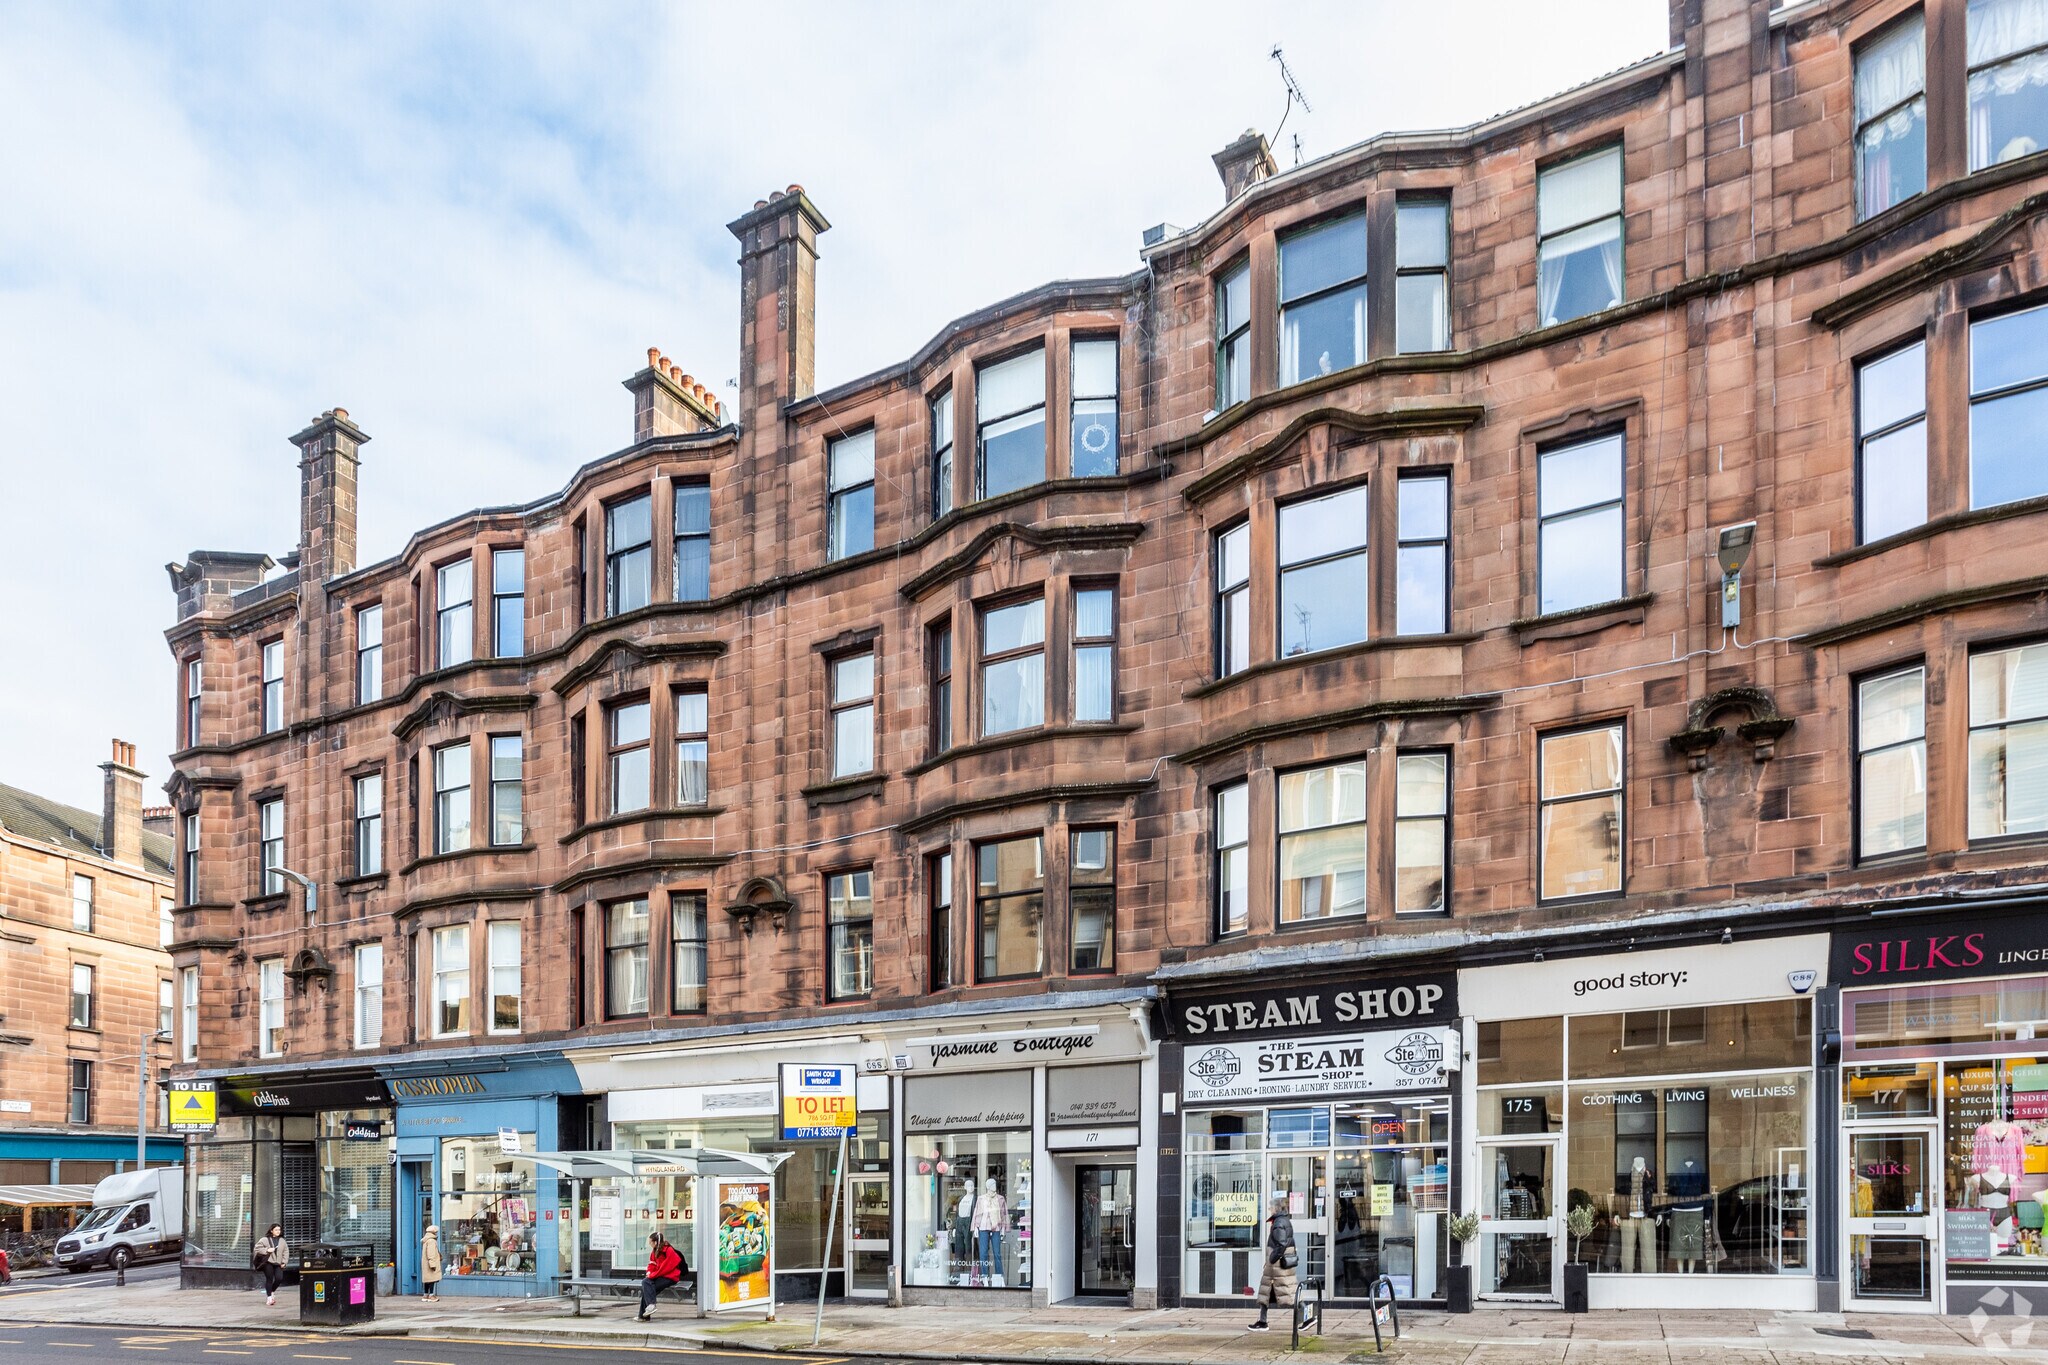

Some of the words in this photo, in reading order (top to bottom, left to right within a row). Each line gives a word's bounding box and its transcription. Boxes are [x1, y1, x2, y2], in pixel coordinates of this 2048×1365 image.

[1852, 933, 1985, 975] SILKS
[1573, 973, 1624, 996] good
[1629, 971, 1688, 988] story:
[1185, 995, 1322, 1034] STEAM
[1334, 984, 1443, 1022] SHOP
[1407, 1034, 1429, 1042] THE
[1270, 1042, 1294, 1051] THE
[930, 1041, 998, 1067] Jasmine
[1209, 1049, 1228, 1057] THE
[1258, 1048, 1364, 1073] STEAM
[1403, 1063, 1431, 1074] SHOP
[1322, 1071, 1353, 1080] SHOP
[1960, 1071, 1994, 1079] LUXURY
[173, 1082, 190, 1091] TO
[192, 1082, 212, 1091] LET
[393, 1075, 487, 1097] CASSIOPEIA
[1205, 1076, 1230, 1086] SHOP
[1418, 1077, 1443, 1085] 0747
[1188, 1090, 1204, 1098] DRY
[1207, 1087, 1253, 1097] CLEANING
[1259, 1085, 1291, 1094] IRONING
[1295, 1082, 1330, 1092] LAUNDRY
[1333, 1080, 1367, 1090] SERVICE
[1960, 1084, 1979, 1092] CUP
[1582, 1093, 1642, 1106] CLOTHING
[1666, 1090, 1705, 1103] LIVING
[1730, 1086, 1796, 1099] WELLNESS
[1871, 1089, 1904, 1104] 177
[796, 1097, 818, 1114] TO
[823, 1097, 846, 1114] LET
[1506, 1099, 1532, 1112] 175
[1960, 1109, 1978, 1117] BRA
[910, 1115, 942, 1128] Unique
[944, 1112, 982, 1126] personal
[985, 1110, 1025, 1124] shopping
[347, 1126, 379, 1138] Oddbins
[797, 1127, 819, 1138] 07714
[1372, 1122, 1406, 1134] OPEN
[1085, 1133, 1099, 1142] 171
[1867, 1164, 1911, 1175] SILKS
